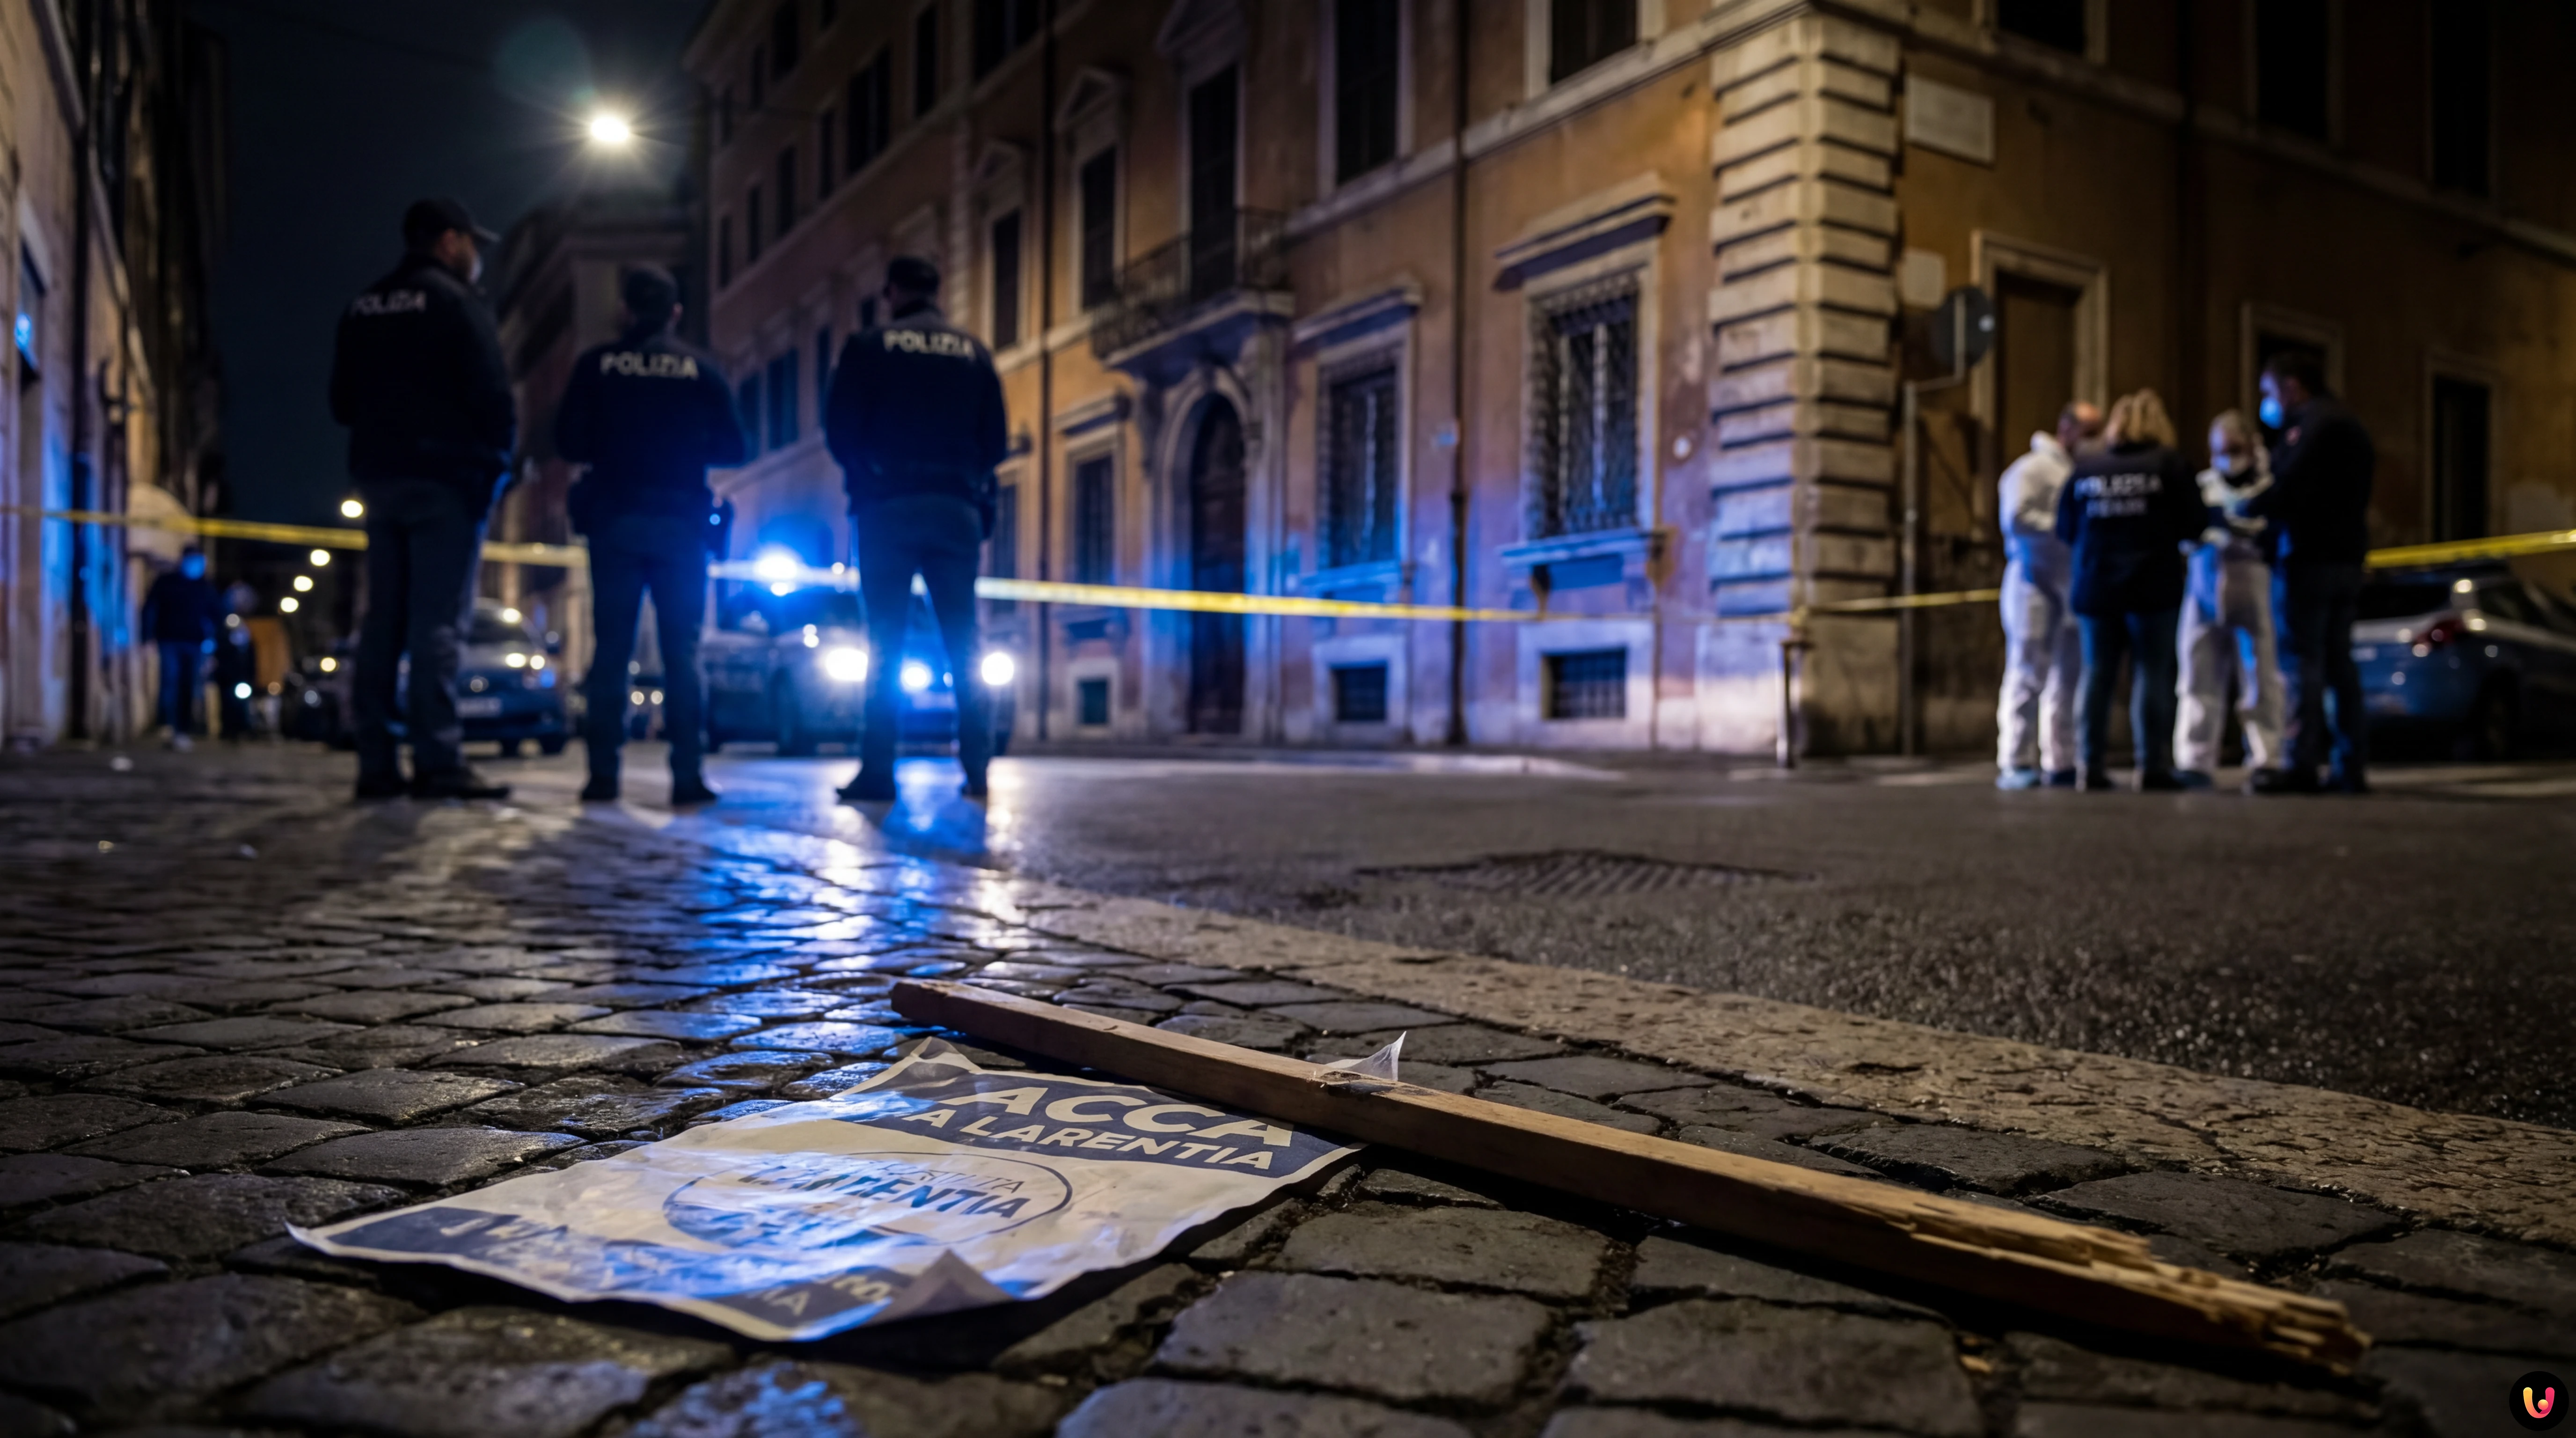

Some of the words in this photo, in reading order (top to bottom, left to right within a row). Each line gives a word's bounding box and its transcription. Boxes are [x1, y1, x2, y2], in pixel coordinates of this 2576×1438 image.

[883, 330, 976, 361] POLIZIA
[600, 352, 699, 380] POLIZIA
[959, 1115, 1274, 1170] LARENTIA
